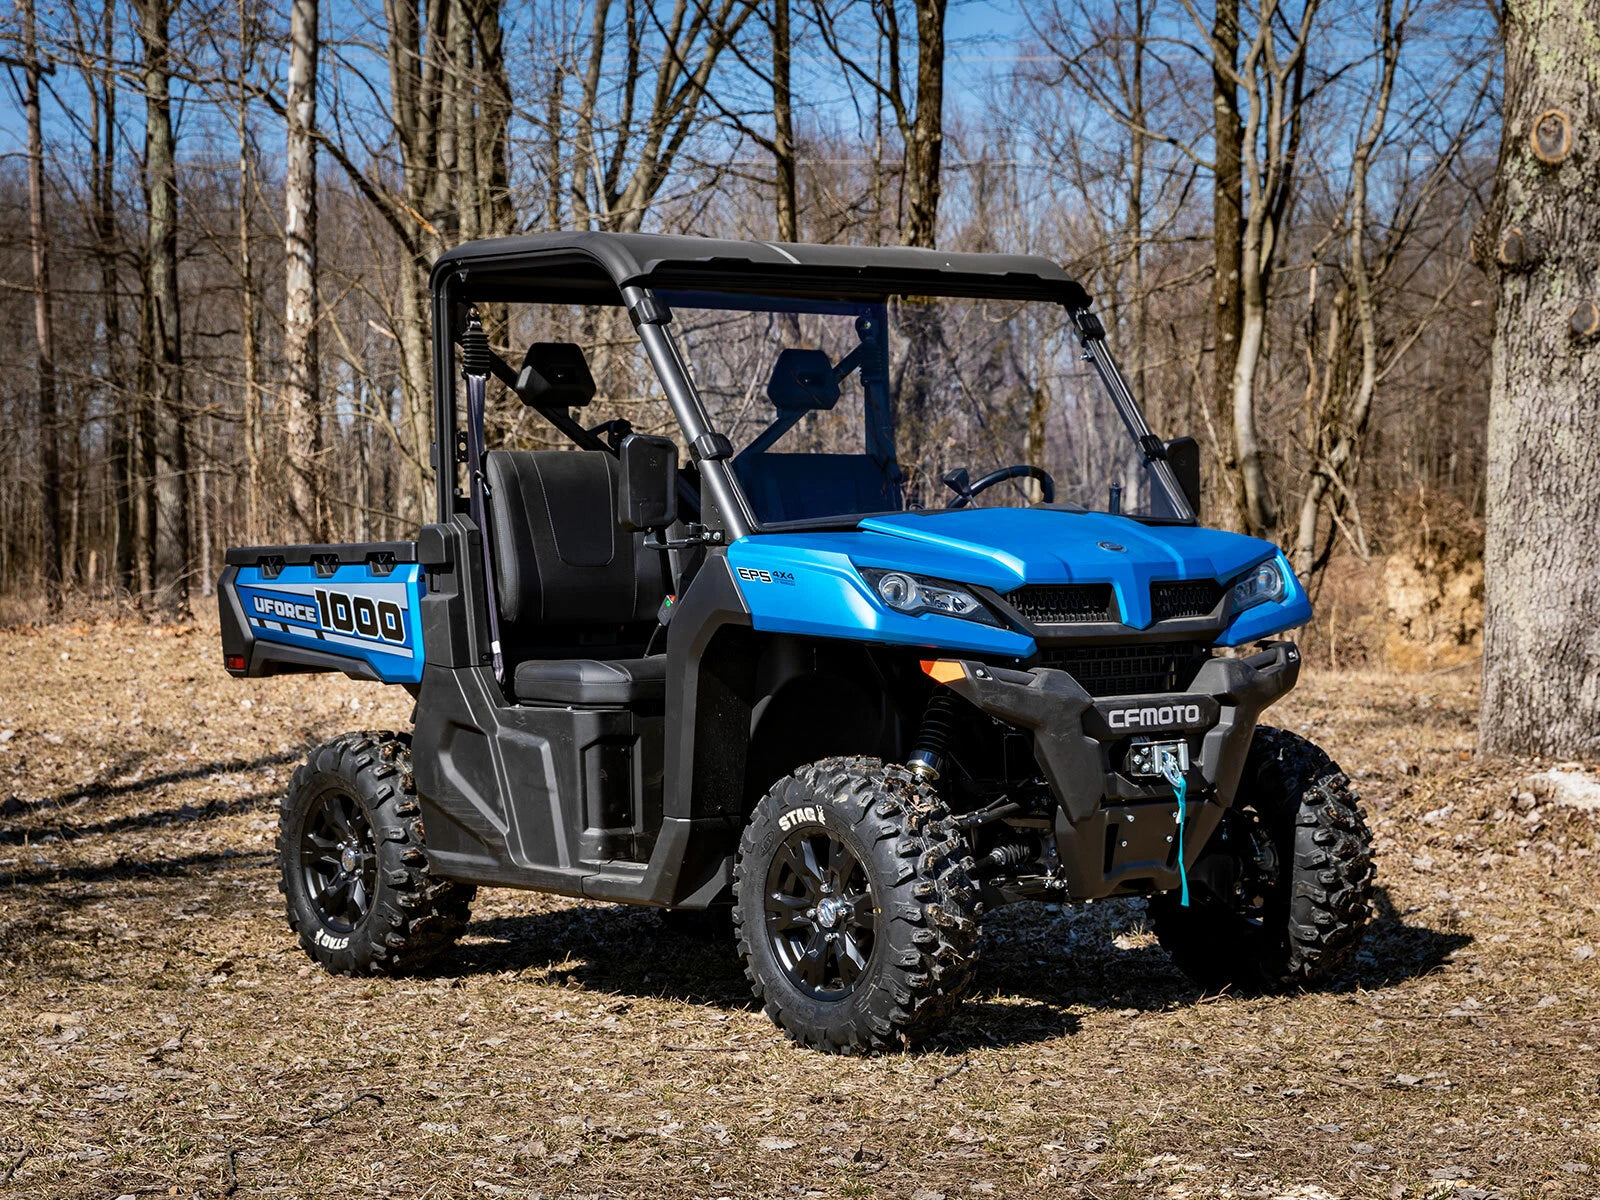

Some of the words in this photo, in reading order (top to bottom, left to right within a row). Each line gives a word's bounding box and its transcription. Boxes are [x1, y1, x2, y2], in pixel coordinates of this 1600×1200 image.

[736, 567, 773, 583] EPS
[253, 597, 317, 623] UFORCE
[314, 587, 406, 644] 1000
[1108, 705, 1200, 728] CFMOTO
[778, 807, 817, 832] STAG
[320, 934, 350, 950] STAG
